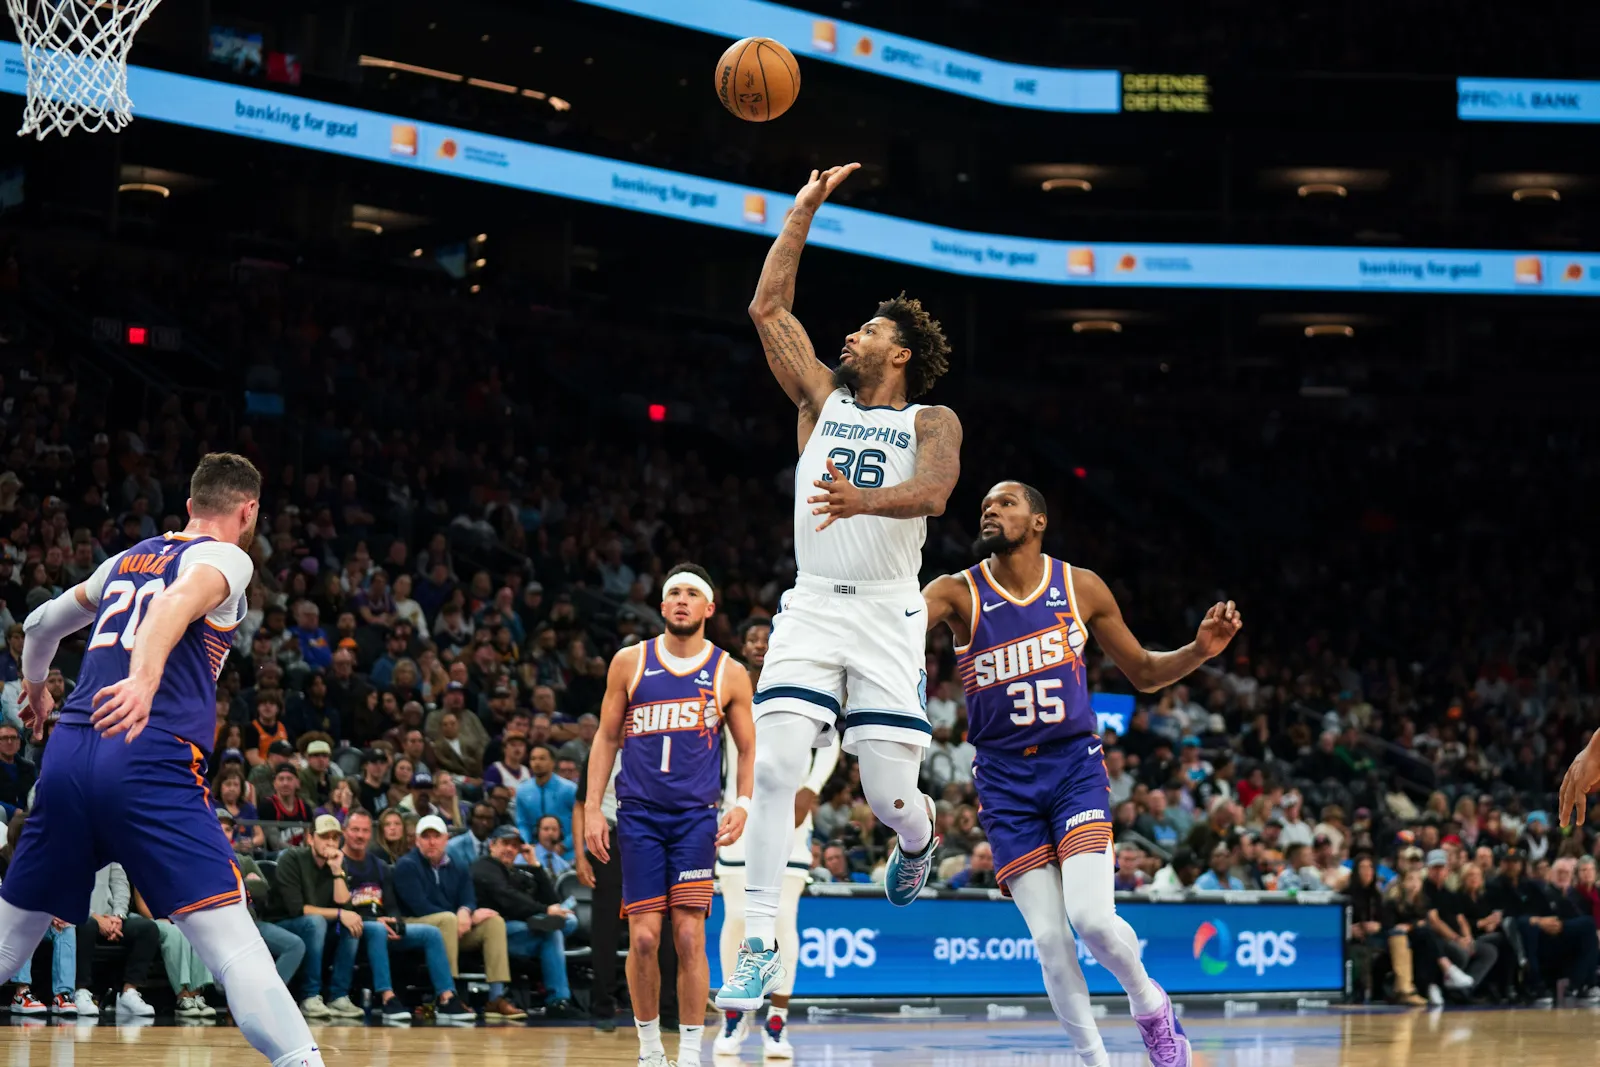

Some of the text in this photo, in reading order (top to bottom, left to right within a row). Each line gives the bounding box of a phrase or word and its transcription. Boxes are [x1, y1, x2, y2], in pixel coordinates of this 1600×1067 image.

[234, 98, 300, 131] banking
[303, 111, 325, 130] for
[326, 120, 358, 138] good
[1530, 92, 1581, 110] BANK
[611, 172, 667, 202] banking
[931, 238, 982, 264] banking
[1359, 258, 1424, 279] banking
[821, 420, 911, 449] MEMPHIS
[821, 447, 887, 488] 36
[88, 578, 166, 651] 20
[1045, 599, 1067, 607] PayPal
[974, 629, 1065, 688] SUNS
[632, 701, 701, 735] SUNS
[1006, 678, 1065, 726] 35
[660, 735, 672, 773] 1
[1065, 809, 1106, 832] PHOENIX
[800, 927, 877, 978] aps
[1235, 931, 1298, 976] aps
